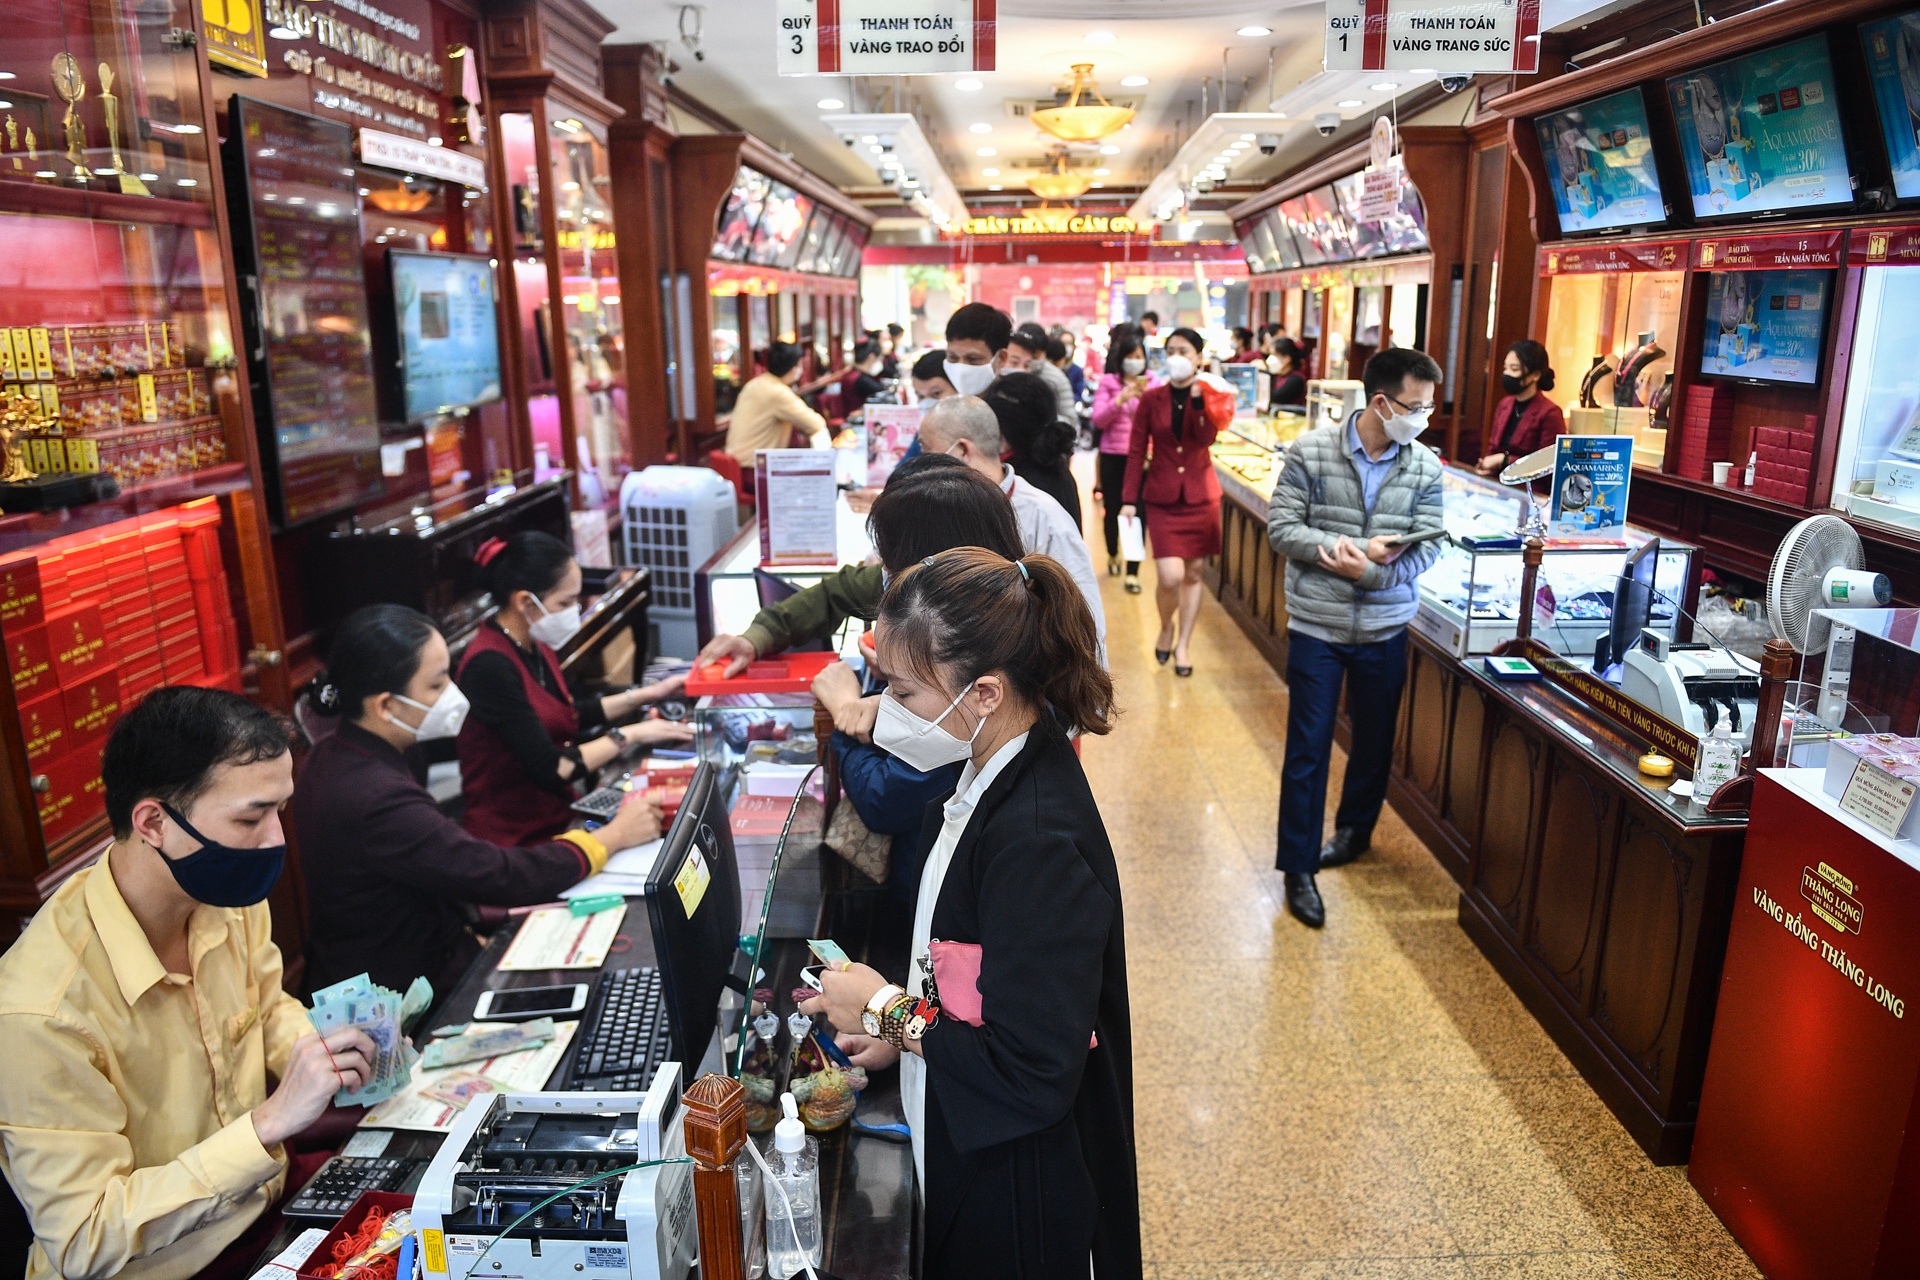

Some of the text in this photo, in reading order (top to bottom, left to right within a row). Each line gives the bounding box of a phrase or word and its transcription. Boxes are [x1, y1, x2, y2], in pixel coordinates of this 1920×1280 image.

[782, 15, 811, 29] QUỸ
[861, 14, 953, 30] THANH TOÁN
[1331, 15, 1360, 29] QUỸ
[1411, 14, 1495, 30] THANH TOÁN
[791, 35, 803, 54] 3
[850, 35, 964, 54] VÀNG TRAO ĐỔI
[1339, 33, 1348, 52] 1
[1393, 36, 1511, 51] VÀNG TRANG SỨC
[1762, 120, 1837, 153] AQUAMARINE
[1798, 241, 1807, 251] 15
[1562, 461, 1624, 473] AQUAMARINE
[1574, 674, 1590, 694] HÀNG
[1605, 694, 1617, 711] TRA
[1617, 701, 1632, 723] TIỀN,
[1633, 710, 1651, 732] VÀNG
[1652, 722, 1677, 748] TRƯỚC
[1677, 739, 1690, 757] KHI
[1690, 749, 1698, 761] R
[1820, 865, 1852, 891] VÀNG RỒNG
[1804, 874, 1860, 923] THĂNG LONG
[1753, 887, 1905, 1019] VÀNG RỒNG THĂNG LONG
